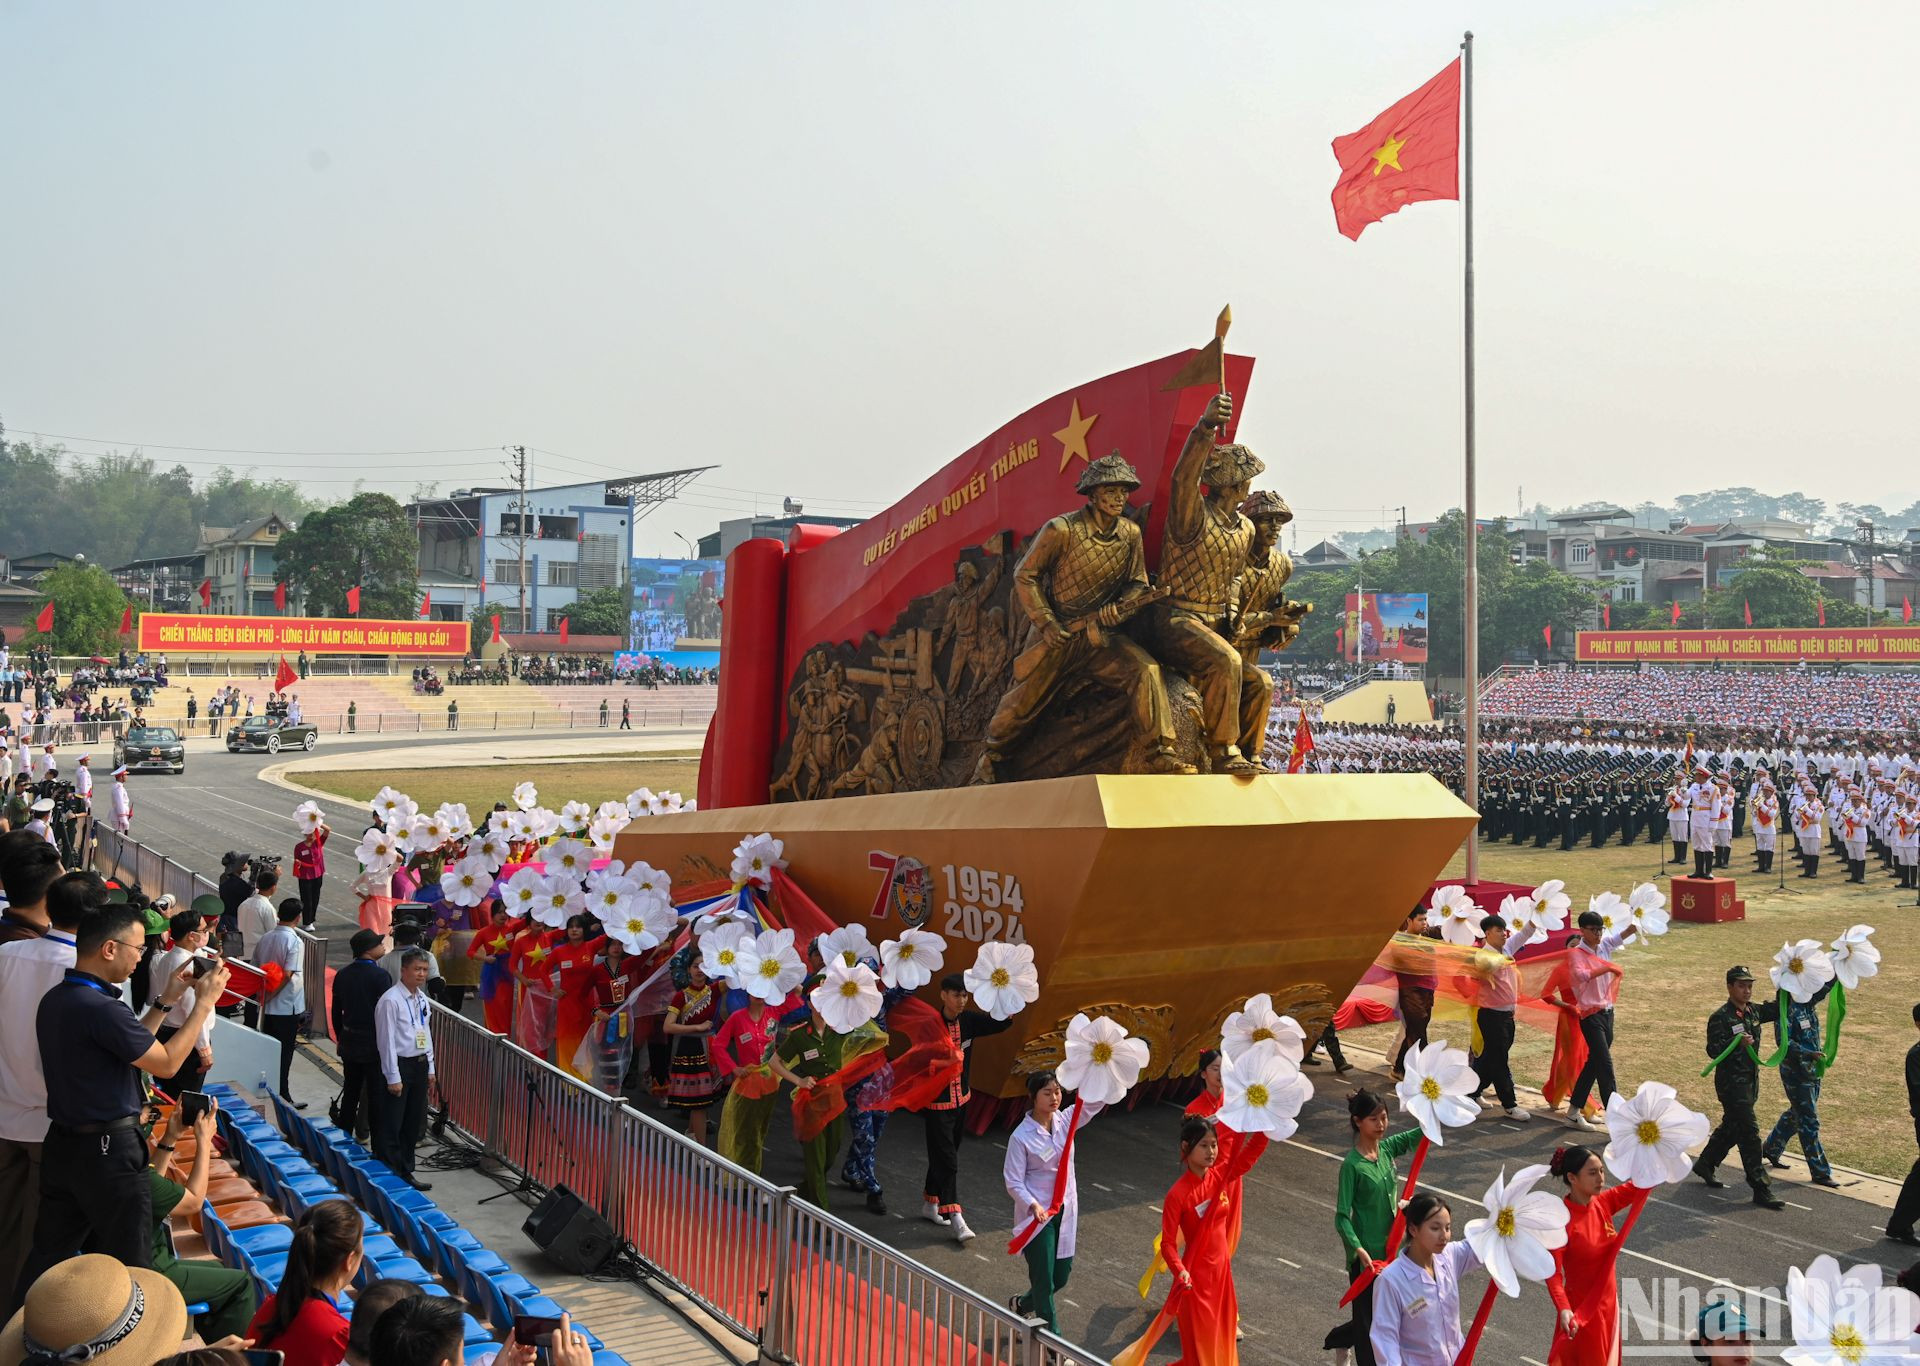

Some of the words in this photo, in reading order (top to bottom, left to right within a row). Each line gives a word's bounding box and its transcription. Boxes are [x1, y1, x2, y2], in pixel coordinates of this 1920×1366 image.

[863, 526, 898, 567] QUYẾT
[900, 504, 938, 541] CHIẾN
[941, 472, 988, 517] QUYẾT
[990, 438, 1040, 482] THẮNG
[160, 622, 185, 642] CHIẾN
[186, 622, 213, 643] THẮNG
[215, 625, 234, 646] ĐIỆN
[236, 625, 256, 643] BIÊN
[257, 624, 274, 643] PHỦ
[321, 627, 341, 645] NĂM
[342, 627, 366, 646] CHÂU,
[367, 626, 389, 645] CHẤN
[391, 629, 412, 648] ĐỘNG
[414, 631, 428, 648] ĐỊA
[1590, 638, 1612, 654] PHÁT
[1614, 640, 1632, 654] HUY
[1634, 640, 1661, 656] MẠNH
[1680, 640, 1702, 654] TINH
[1732, 635, 1762, 654] CHIẾN
[1764, 634, 1797, 653] THẮNG
[1800, 636, 1825, 656] ĐIỆN
[1828, 635, 1853, 653] BIÊN
[1856, 633, 1878, 653] PHỦ
[1882, 638, 1920, 653] TRONG
[942, 864, 1024, 913] 1954
[943, 901, 1027, 944] 2024
